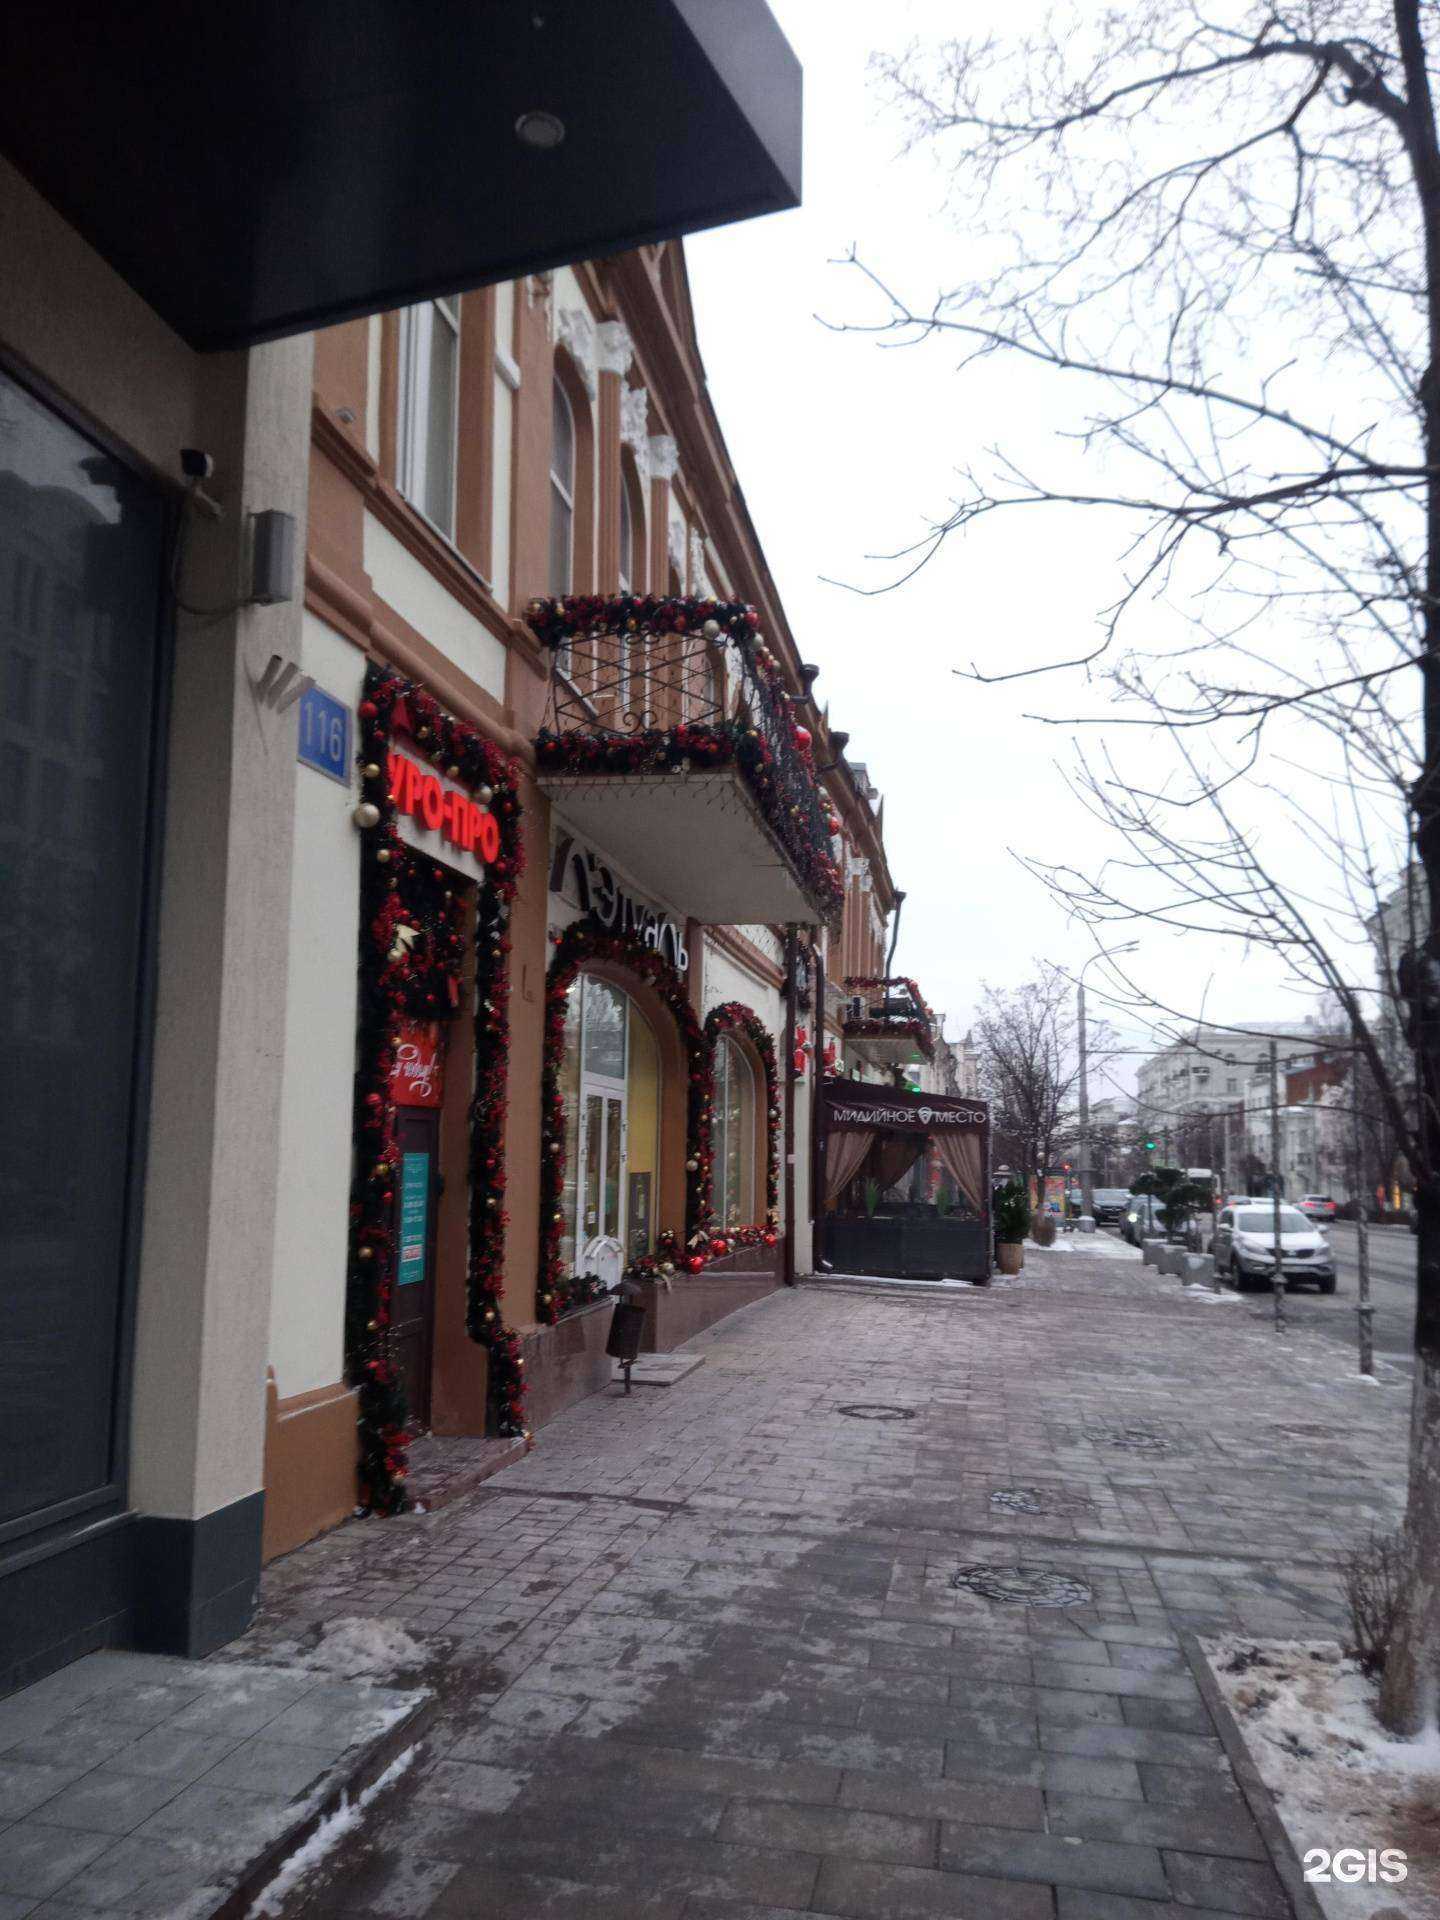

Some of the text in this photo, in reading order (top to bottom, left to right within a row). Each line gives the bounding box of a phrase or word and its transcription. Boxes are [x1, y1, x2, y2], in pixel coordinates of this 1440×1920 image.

[303, 702, 343, 763] 116
[387, 752, 500, 863] УРО-ПРО
[833, 1108, 986, 1124] МИДИЙНОЕ МЕСТО
